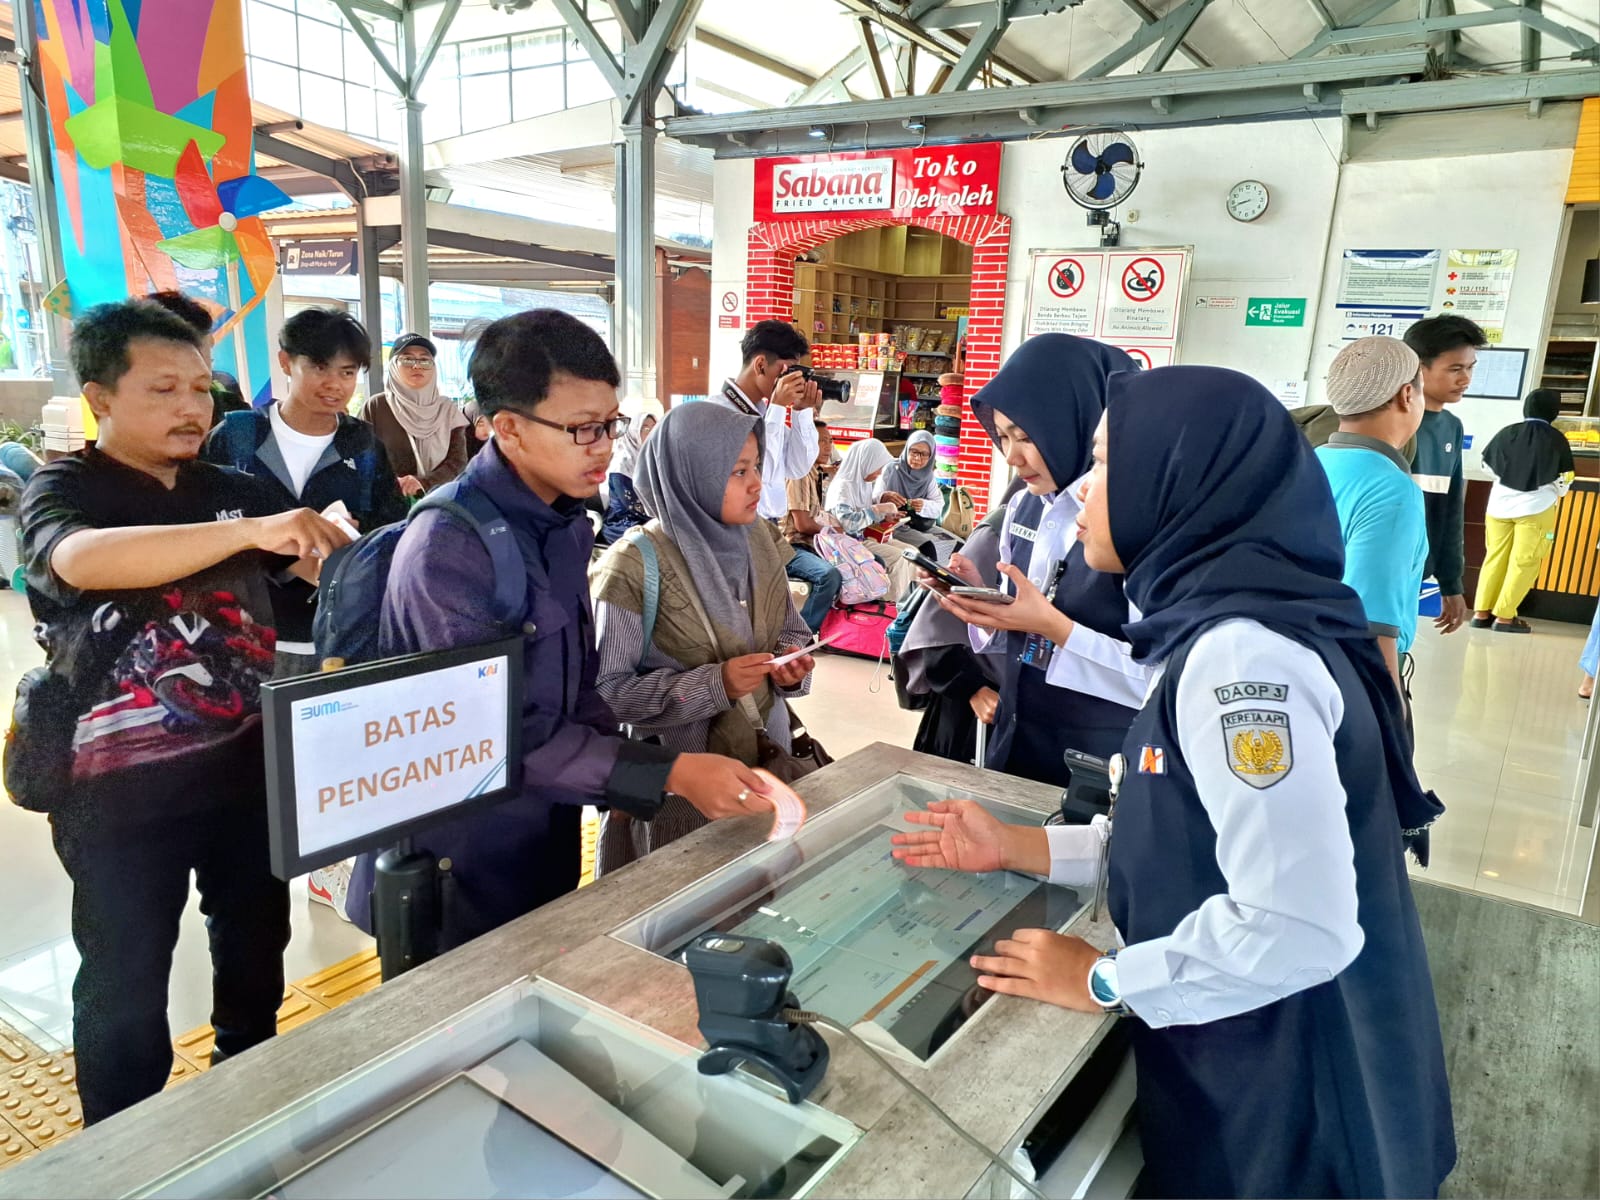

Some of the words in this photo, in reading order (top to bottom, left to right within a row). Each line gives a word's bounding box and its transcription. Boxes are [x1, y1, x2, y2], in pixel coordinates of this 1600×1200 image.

[913, 155, 977, 178] Toko
[776, 168, 882, 199] Sabana
[776, 197, 813, 207] FRIED
[823, 196, 884, 206] CHICKEN
[898, 184, 993, 209] Oleh-oleh
[1370, 323, 1393, 335] 121
[1221, 684, 1268, 700] DAOP
[1273, 687, 1282, 697] 3
[301, 701, 340, 720] BUMN
[1224, 712, 1261, 725] KERETA
[1262, 715, 1284, 724] API
[364, 701, 457, 747] BATAS
[318, 739, 494, 813] PENGANTAR
